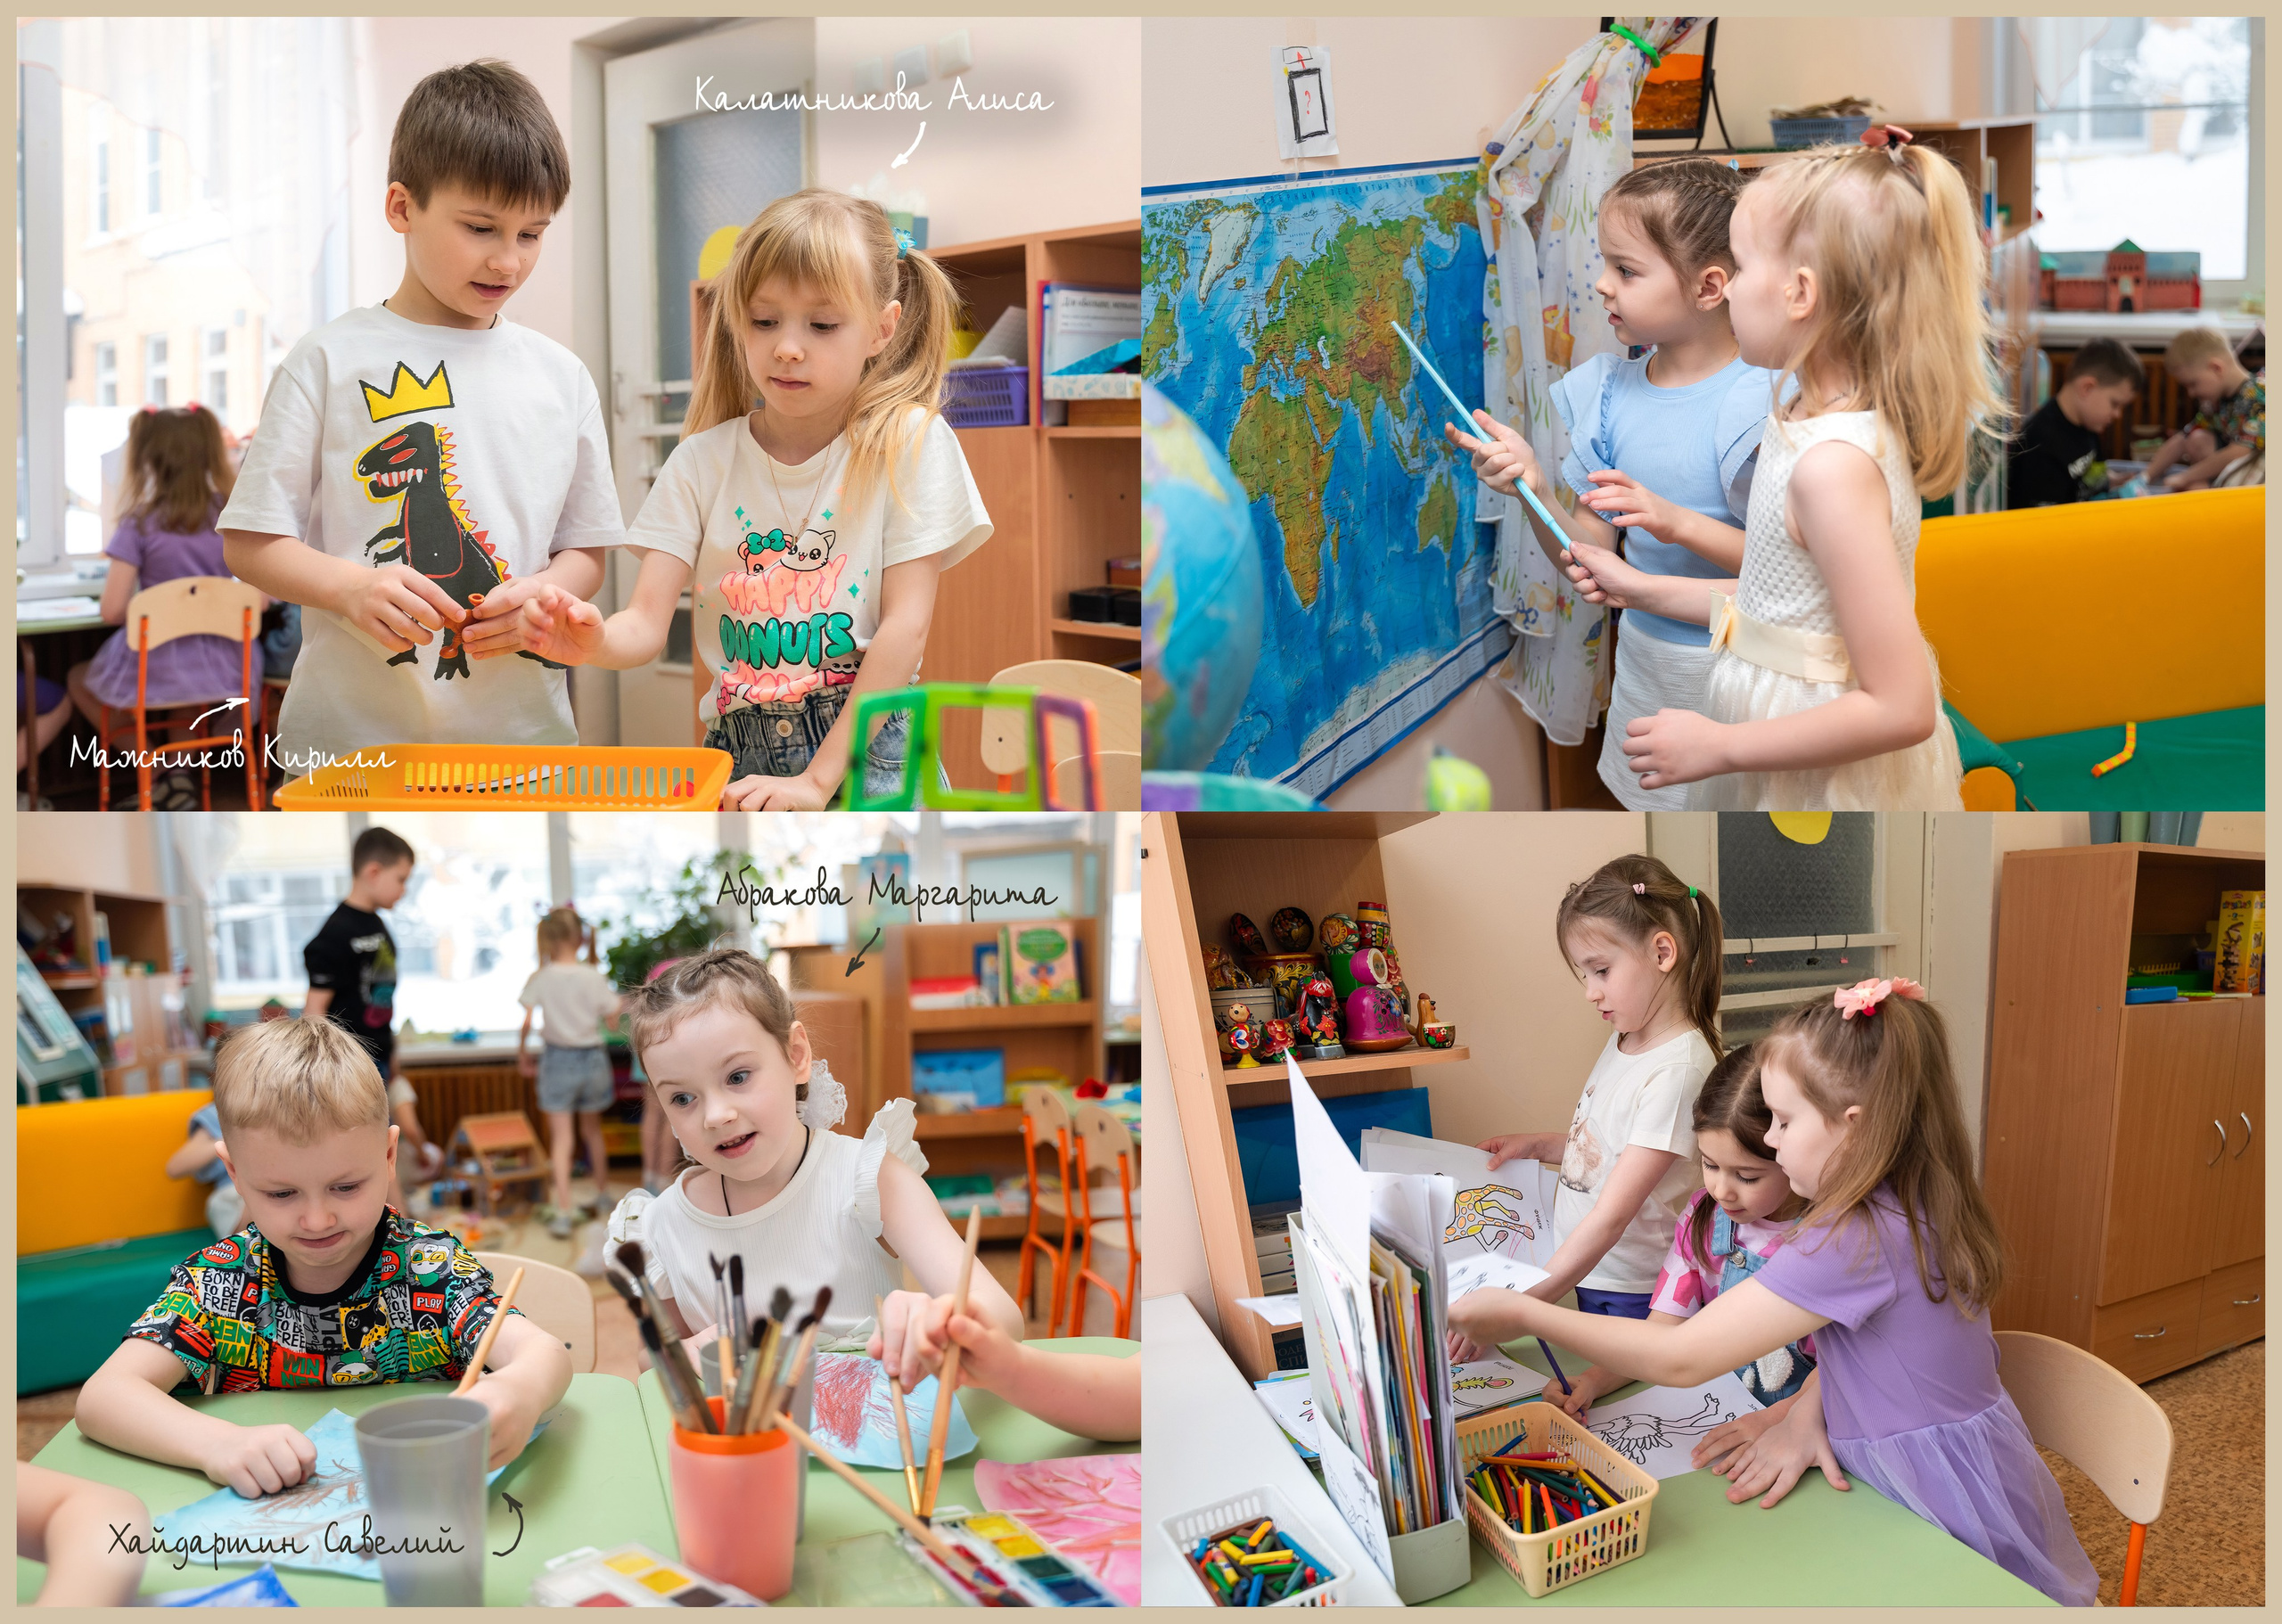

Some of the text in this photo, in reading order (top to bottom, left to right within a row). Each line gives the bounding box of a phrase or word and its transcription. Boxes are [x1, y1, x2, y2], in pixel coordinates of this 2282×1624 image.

[719, 554, 847, 618] HAPPY
[719, 612, 857, 670] DONUTS
[206, 1249, 234, 1260] GAME
[382, 1255, 392, 1264] ON
[201, 1270, 242, 1285] BORN
[202, 1282, 218, 1295] TO
[222, 1286, 239, 1299] BE
[203, 1292, 236, 1312] FREE
[416, 1297, 442, 1309] PLAY
[320, 1305, 343, 1350] PLA
[410, 1333, 438, 1350] NE
[282, 1351, 320, 1377] WIN
